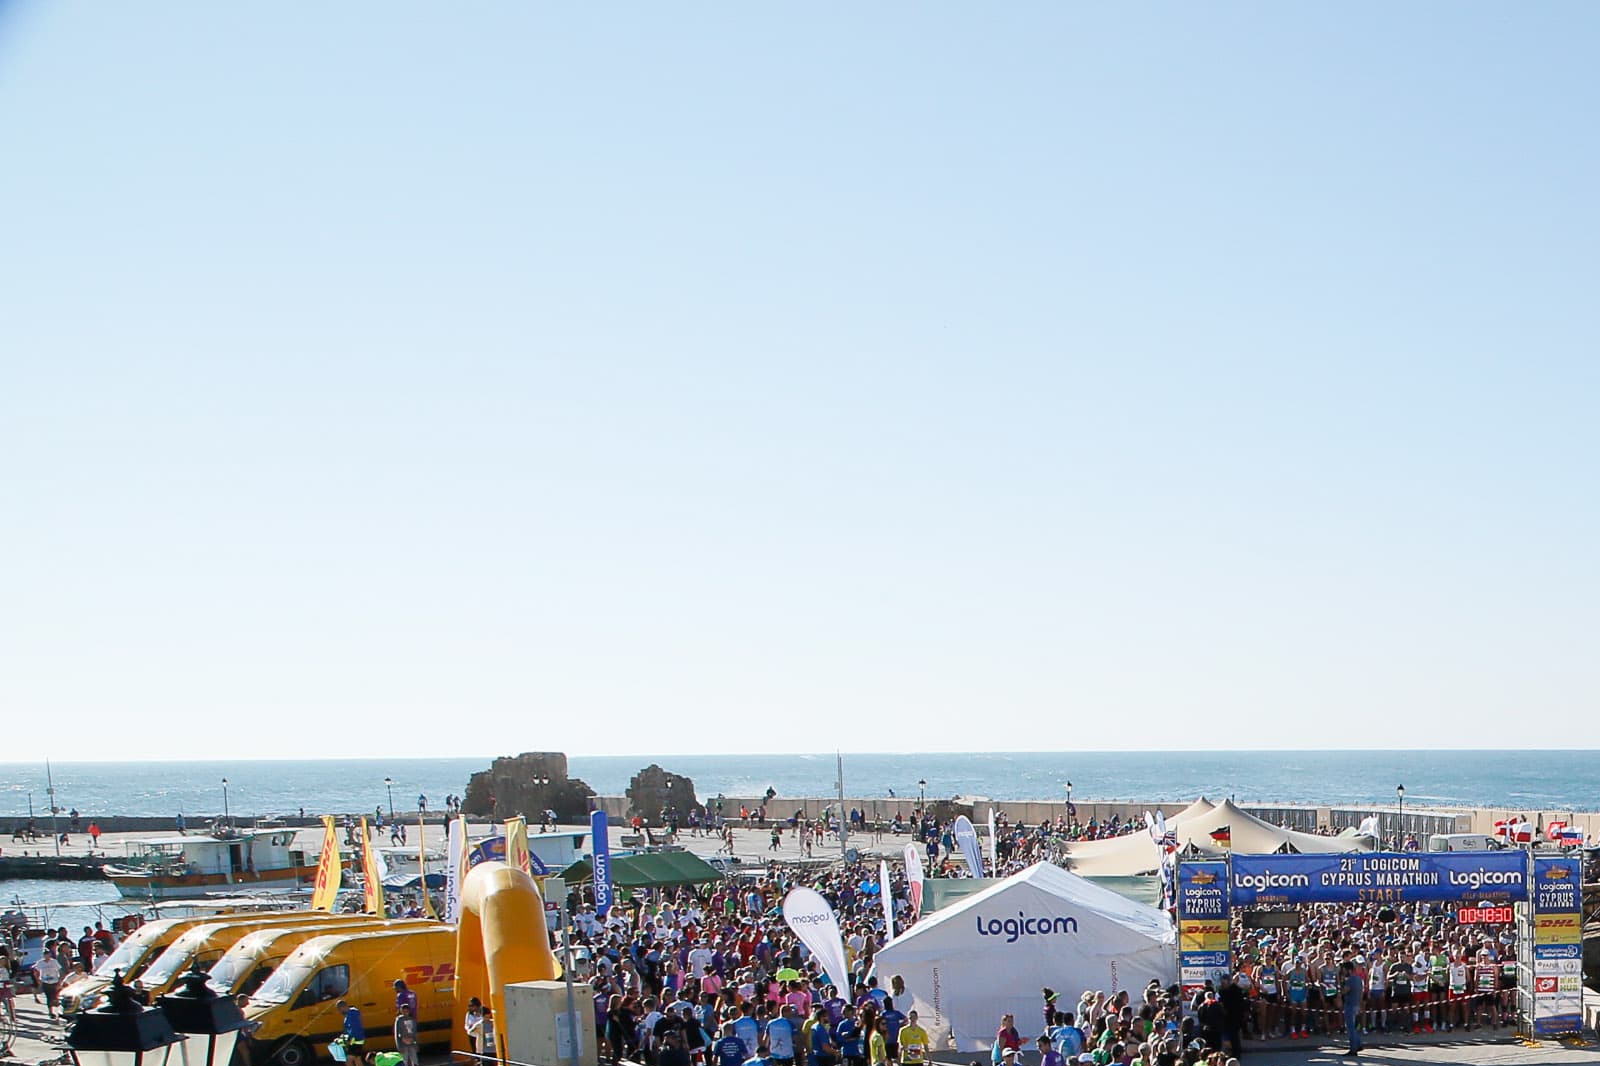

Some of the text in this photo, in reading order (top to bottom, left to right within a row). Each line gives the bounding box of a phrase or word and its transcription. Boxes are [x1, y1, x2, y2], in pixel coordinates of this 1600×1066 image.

[1363, 859, 1419, 871] LOGICOM
[596, 854, 609, 905] Logicom
[1235, 869, 1309, 892] Logicom
[1321, 872, 1438, 886] CYPRUS MARATHON
[1449, 867, 1522, 890] Logicom
[446, 865, 457, 919] ogicom
[1185, 887, 1222, 898] Logicom
[1540, 882, 1574, 892] Logicom
[1359, 889, 1403, 901] START
[1540, 892, 1574, 902] CYPRUS
[1185, 899, 1222, 908] CYPRUS
[977, 911, 1078, 943] Logicom
[1186, 925, 1223, 934] DHL
[1540, 919, 1576, 928] DHL
[402, 963, 456, 986] DH
